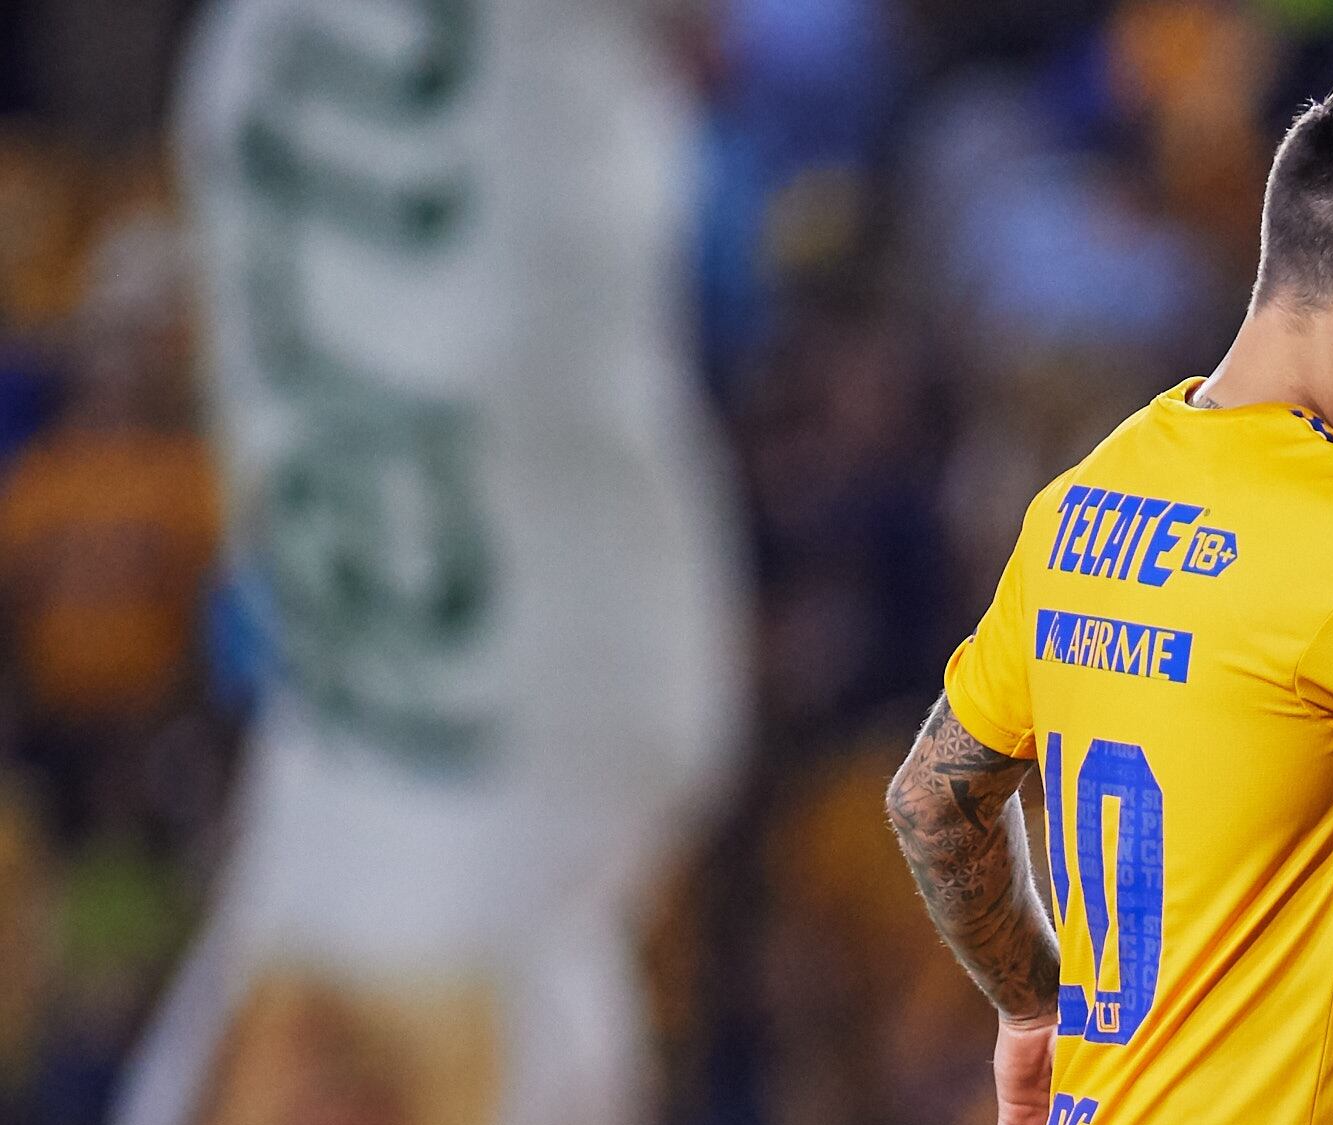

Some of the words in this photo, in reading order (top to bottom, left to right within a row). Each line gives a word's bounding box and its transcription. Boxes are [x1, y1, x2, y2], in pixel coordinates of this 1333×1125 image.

[1047, 484, 1205, 588] TECATE
[1188, 531, 1236, 571] 18+
[1065, 617, 1176, 681] AFIRME
[1044, 730, 1165, 1046] 10
